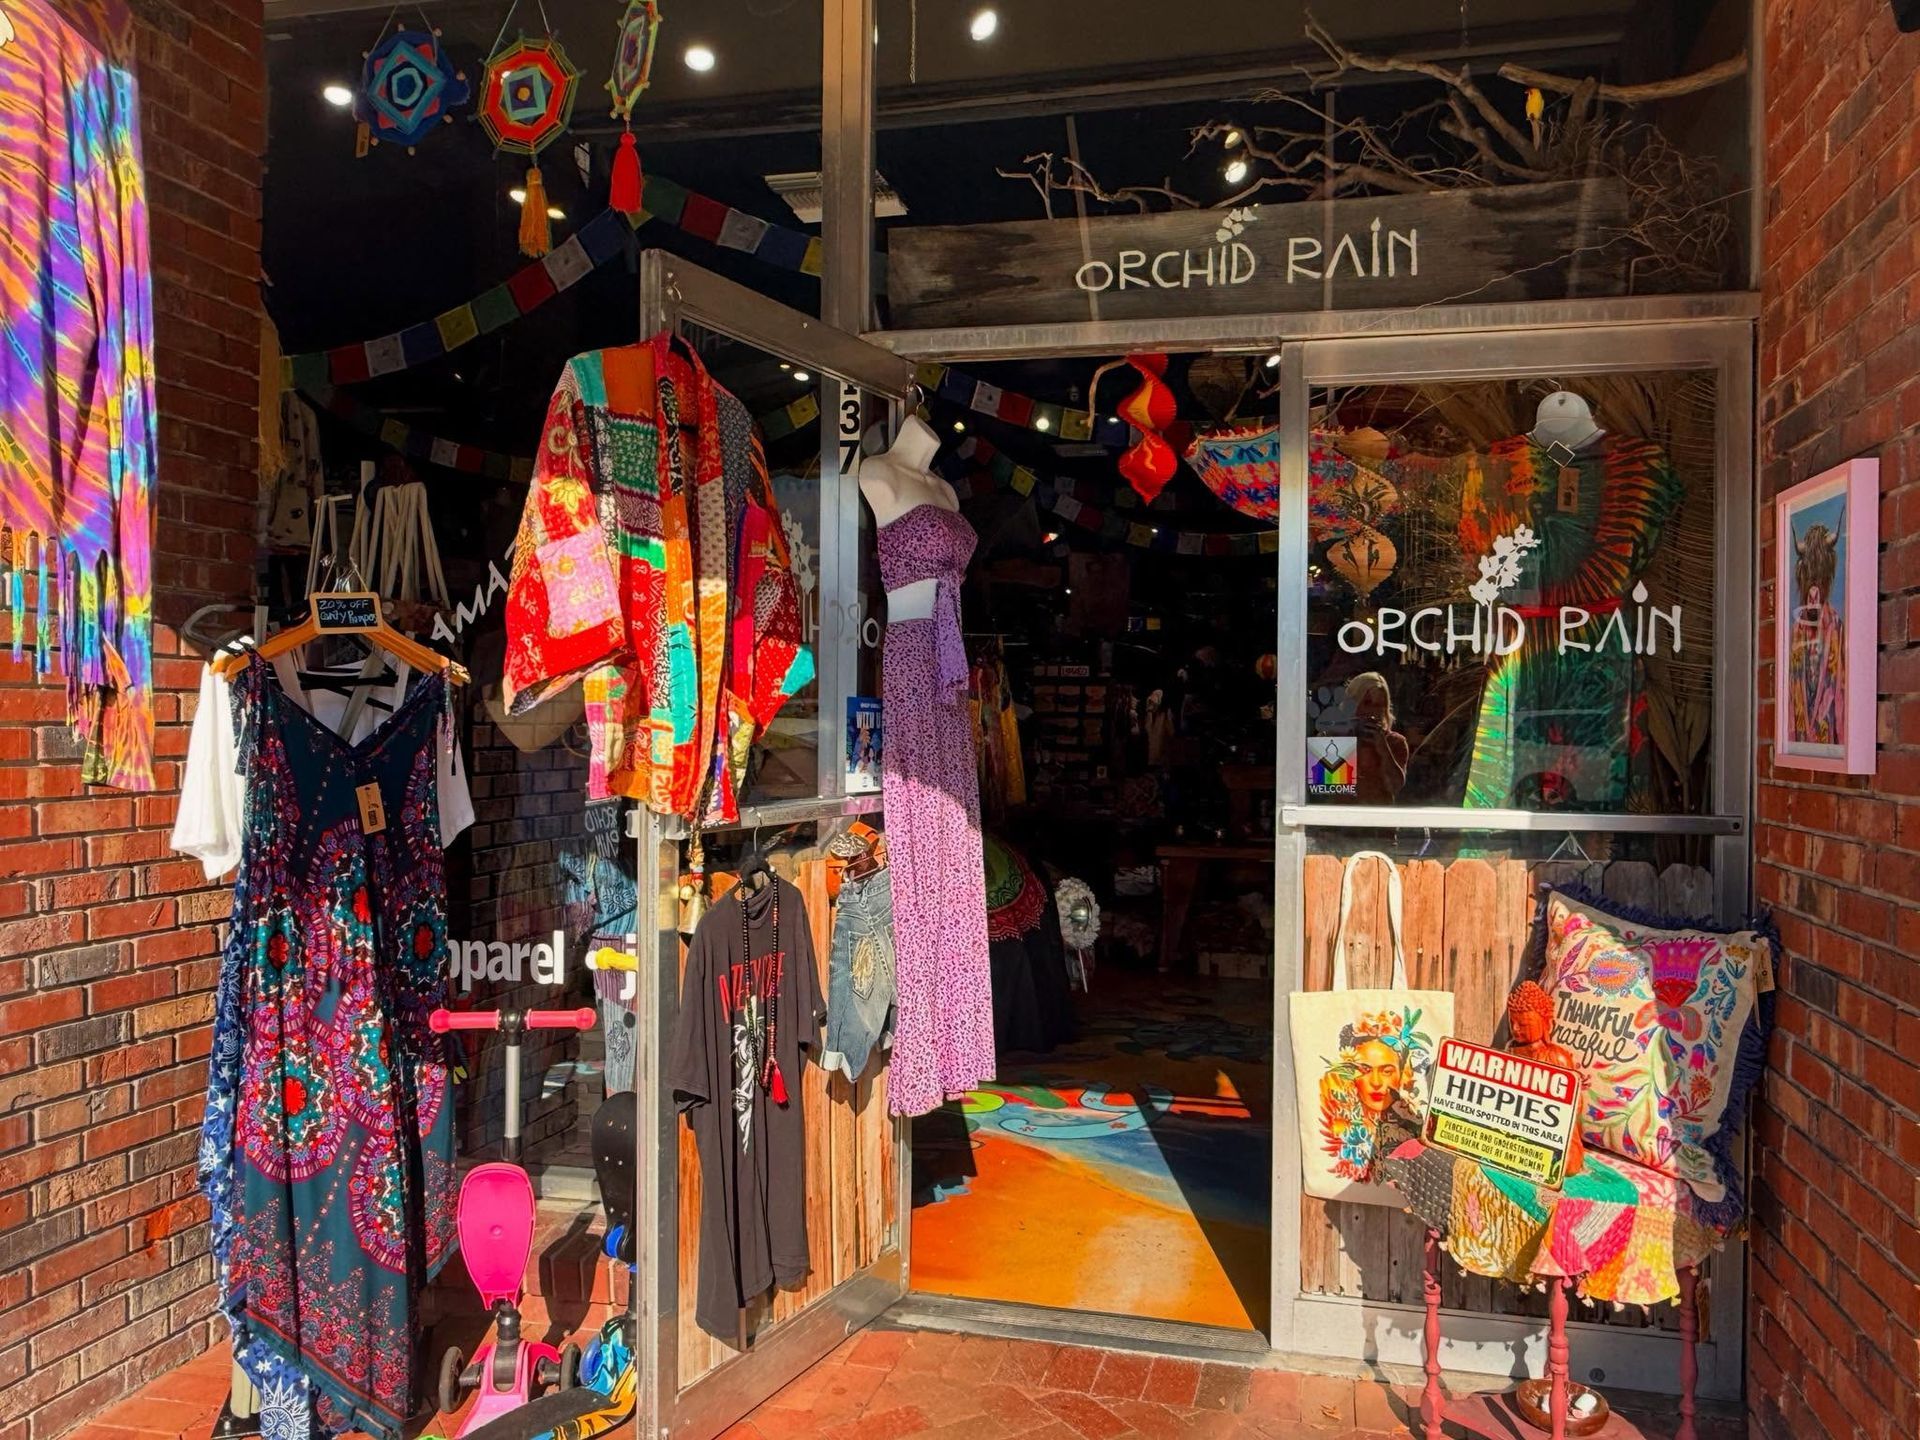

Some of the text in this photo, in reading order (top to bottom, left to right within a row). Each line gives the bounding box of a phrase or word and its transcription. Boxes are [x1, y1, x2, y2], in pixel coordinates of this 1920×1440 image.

[1075, 217, 1417, 292] ORCHID RAIN
[320, 600, 346, 610] 20%
[1337, 580, 1682, 662] ORCHID RAIN
[1309, 784, 1357, 794] WELCOME
[1557, 990, 1636, 1040] THANKFUL
[1550, 1022, 1639, 1068] rateful
[1446, 1043, 1569, 1100] WARNING
[1434, 1096, 1564, 1145] HAVE BEEN SPOTTED IN THIS AREA
[1446, 1075, 1561, 1129] HIPPIES
[1440, 1129, 1545, 1173] COULD BREAK OUT AT ANY MOMENT
[1479, 1131, 1493, 1143] AND
[1494, 1137, 1544, 1161] UNDERSTANDING
